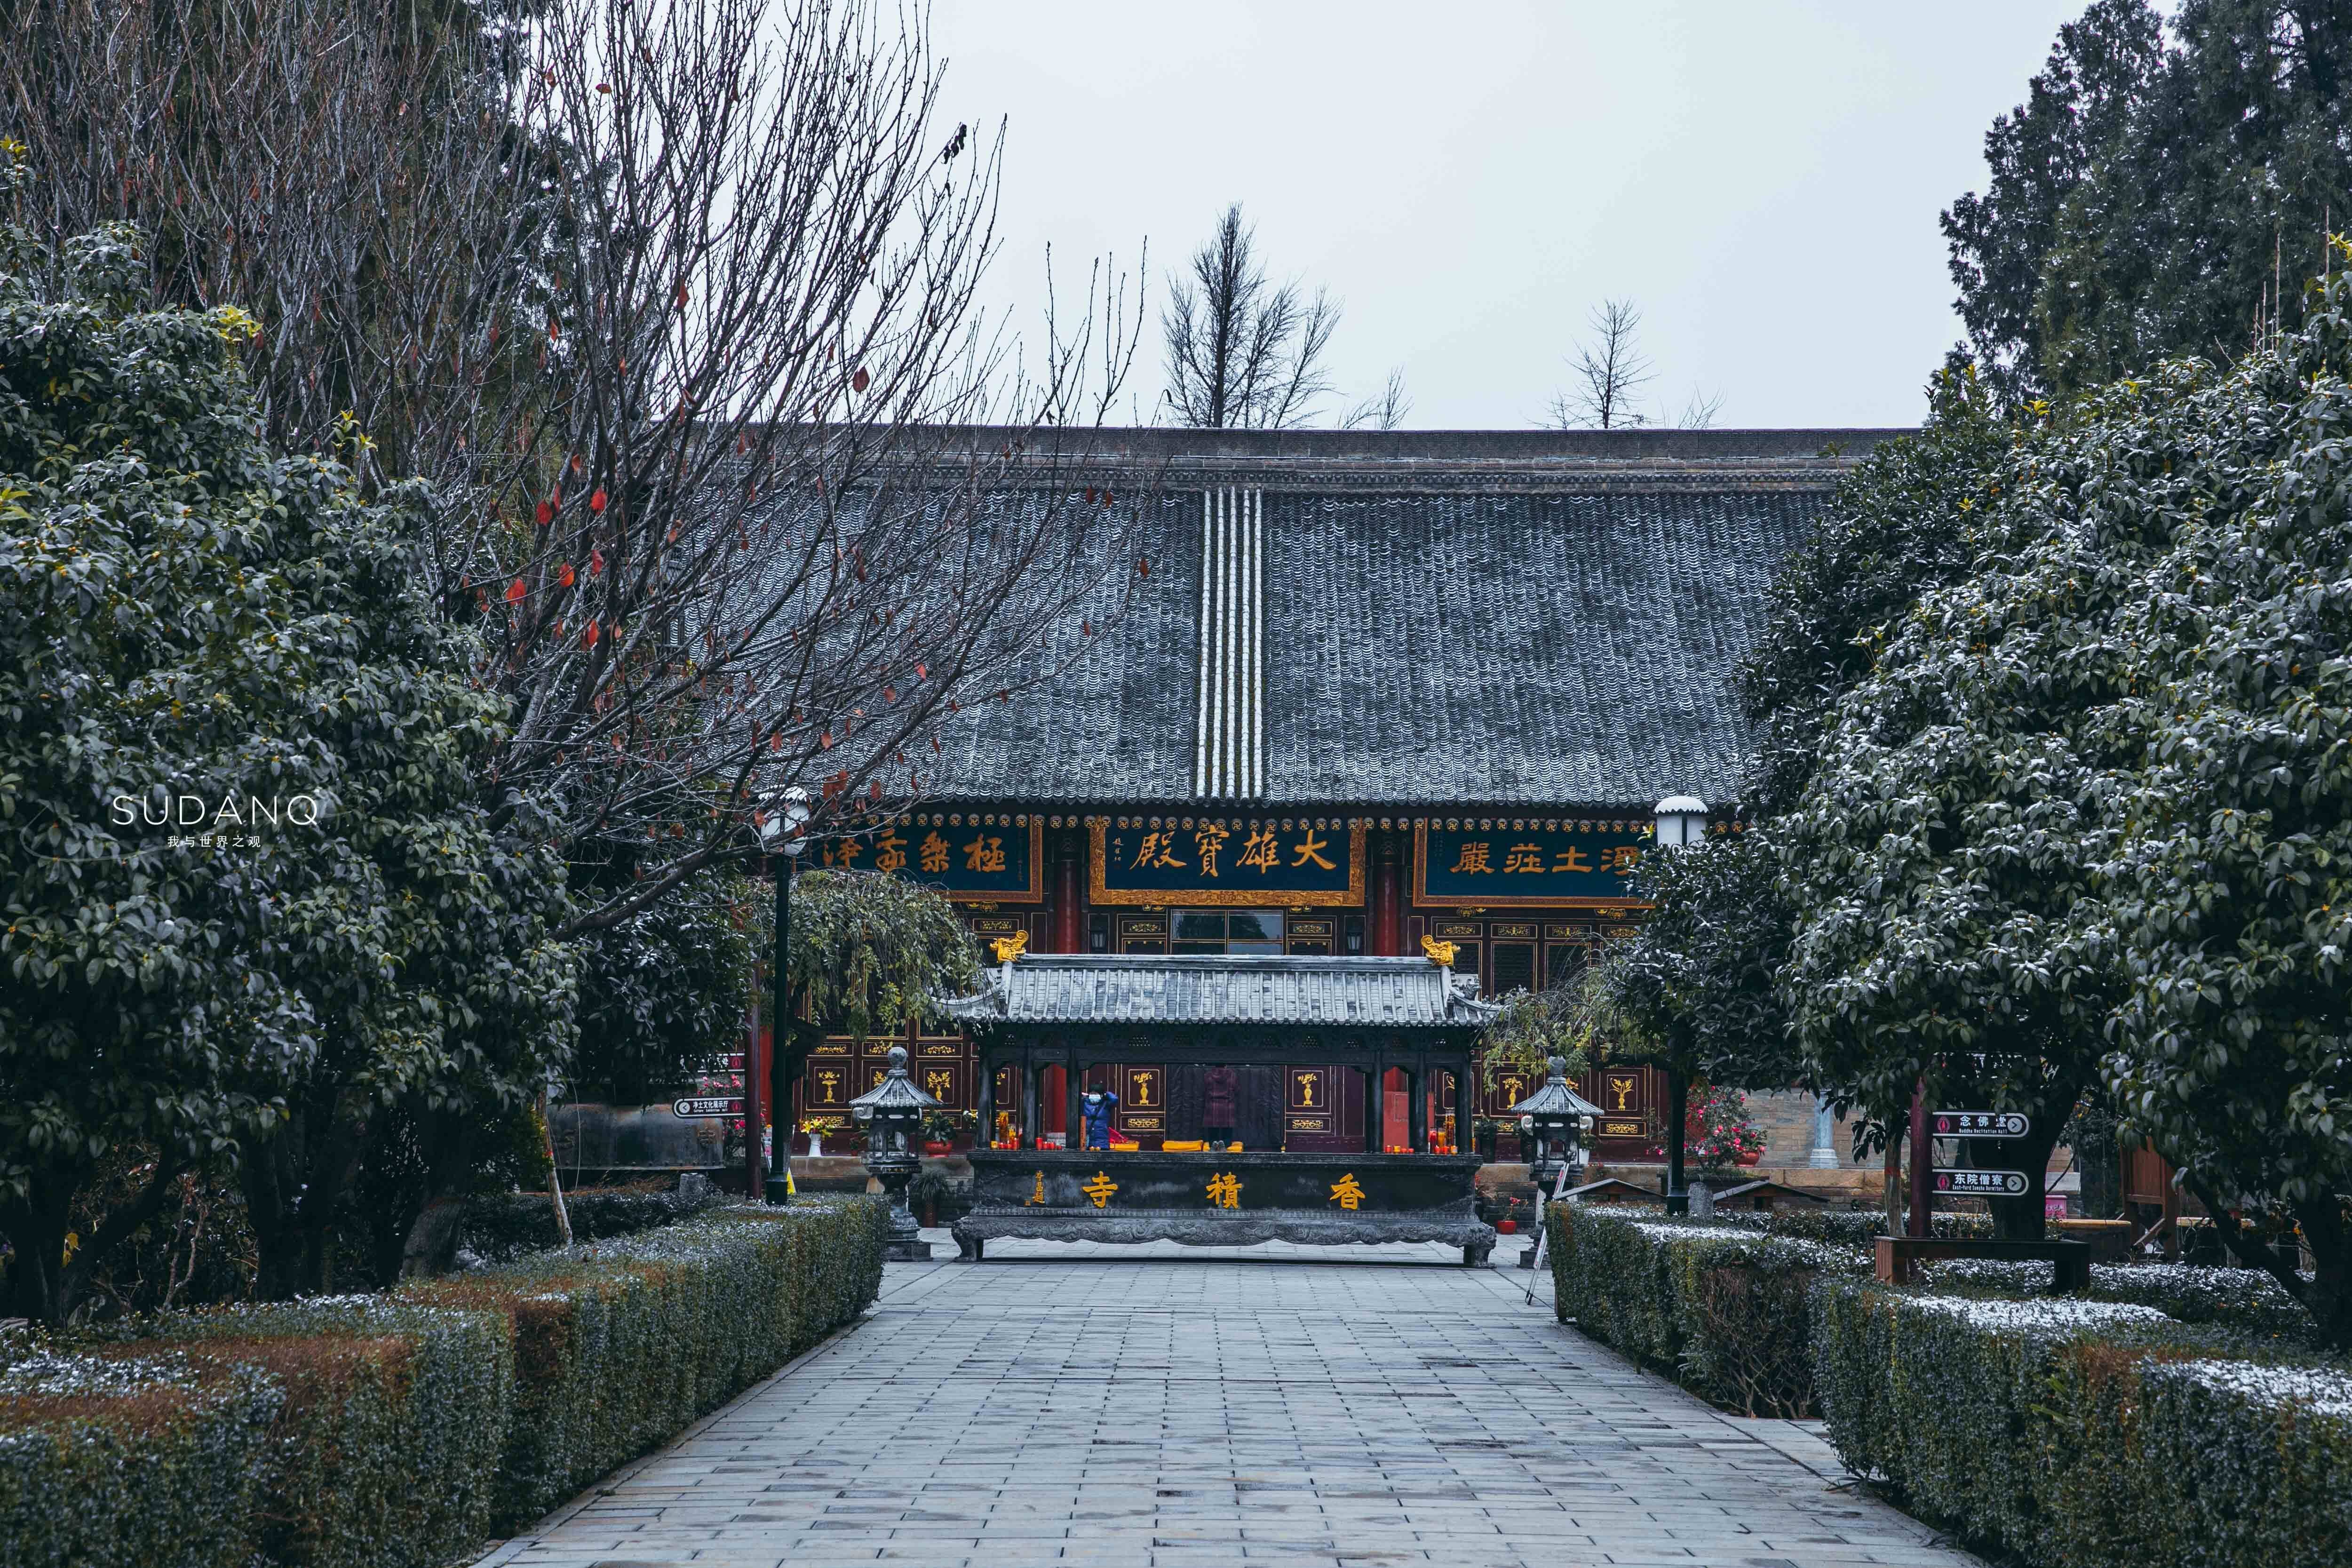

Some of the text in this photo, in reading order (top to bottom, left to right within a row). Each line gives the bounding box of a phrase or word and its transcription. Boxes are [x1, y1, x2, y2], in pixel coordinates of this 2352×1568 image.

[1130, 825, 1336, 876] 大雄寶殿
[1960, 1115, 2006, 1127] 念佛堂
[1082, 1170, 1366, 1210] 香積寺
[1955, 1174, 2002, 1185] 东院僧寮
